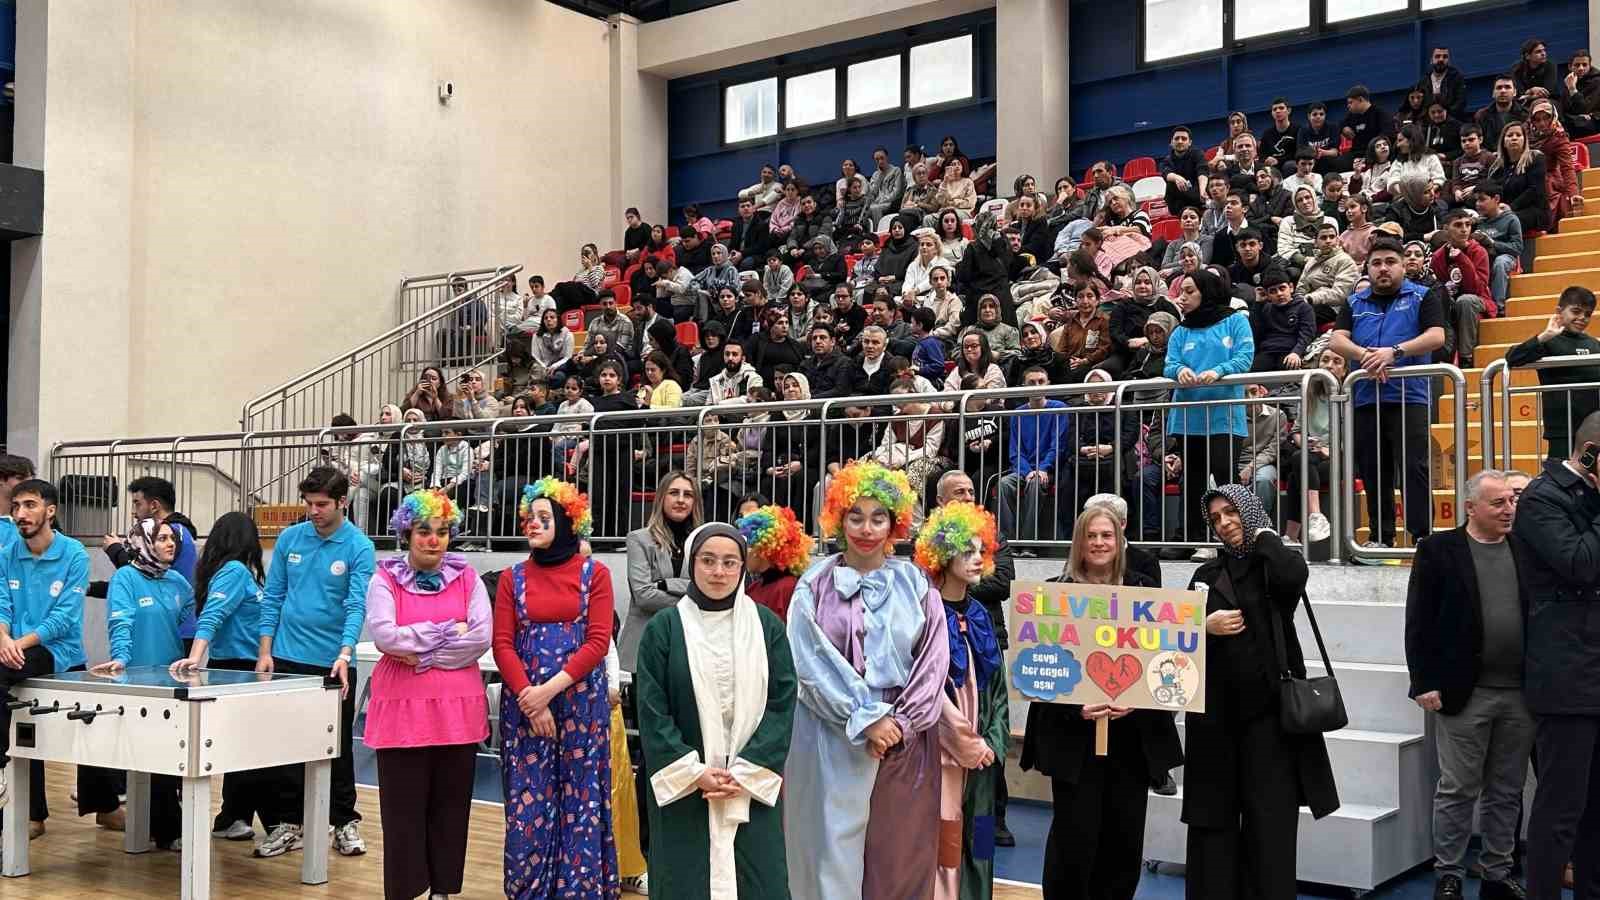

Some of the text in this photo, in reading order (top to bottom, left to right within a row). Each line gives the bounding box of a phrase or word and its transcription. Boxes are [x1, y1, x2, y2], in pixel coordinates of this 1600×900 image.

[1441, 502, 1453, 519] B
[1015, 586, 1201, 626] SİLİVRİ KAPI
[1018, 621, 1199, 653] ANA OKULU
[1032, 653, 1058, 665] sevgi
[1021, 664, 1070, 679] her engeli
[1033, 680, 1056, 691] aşar
